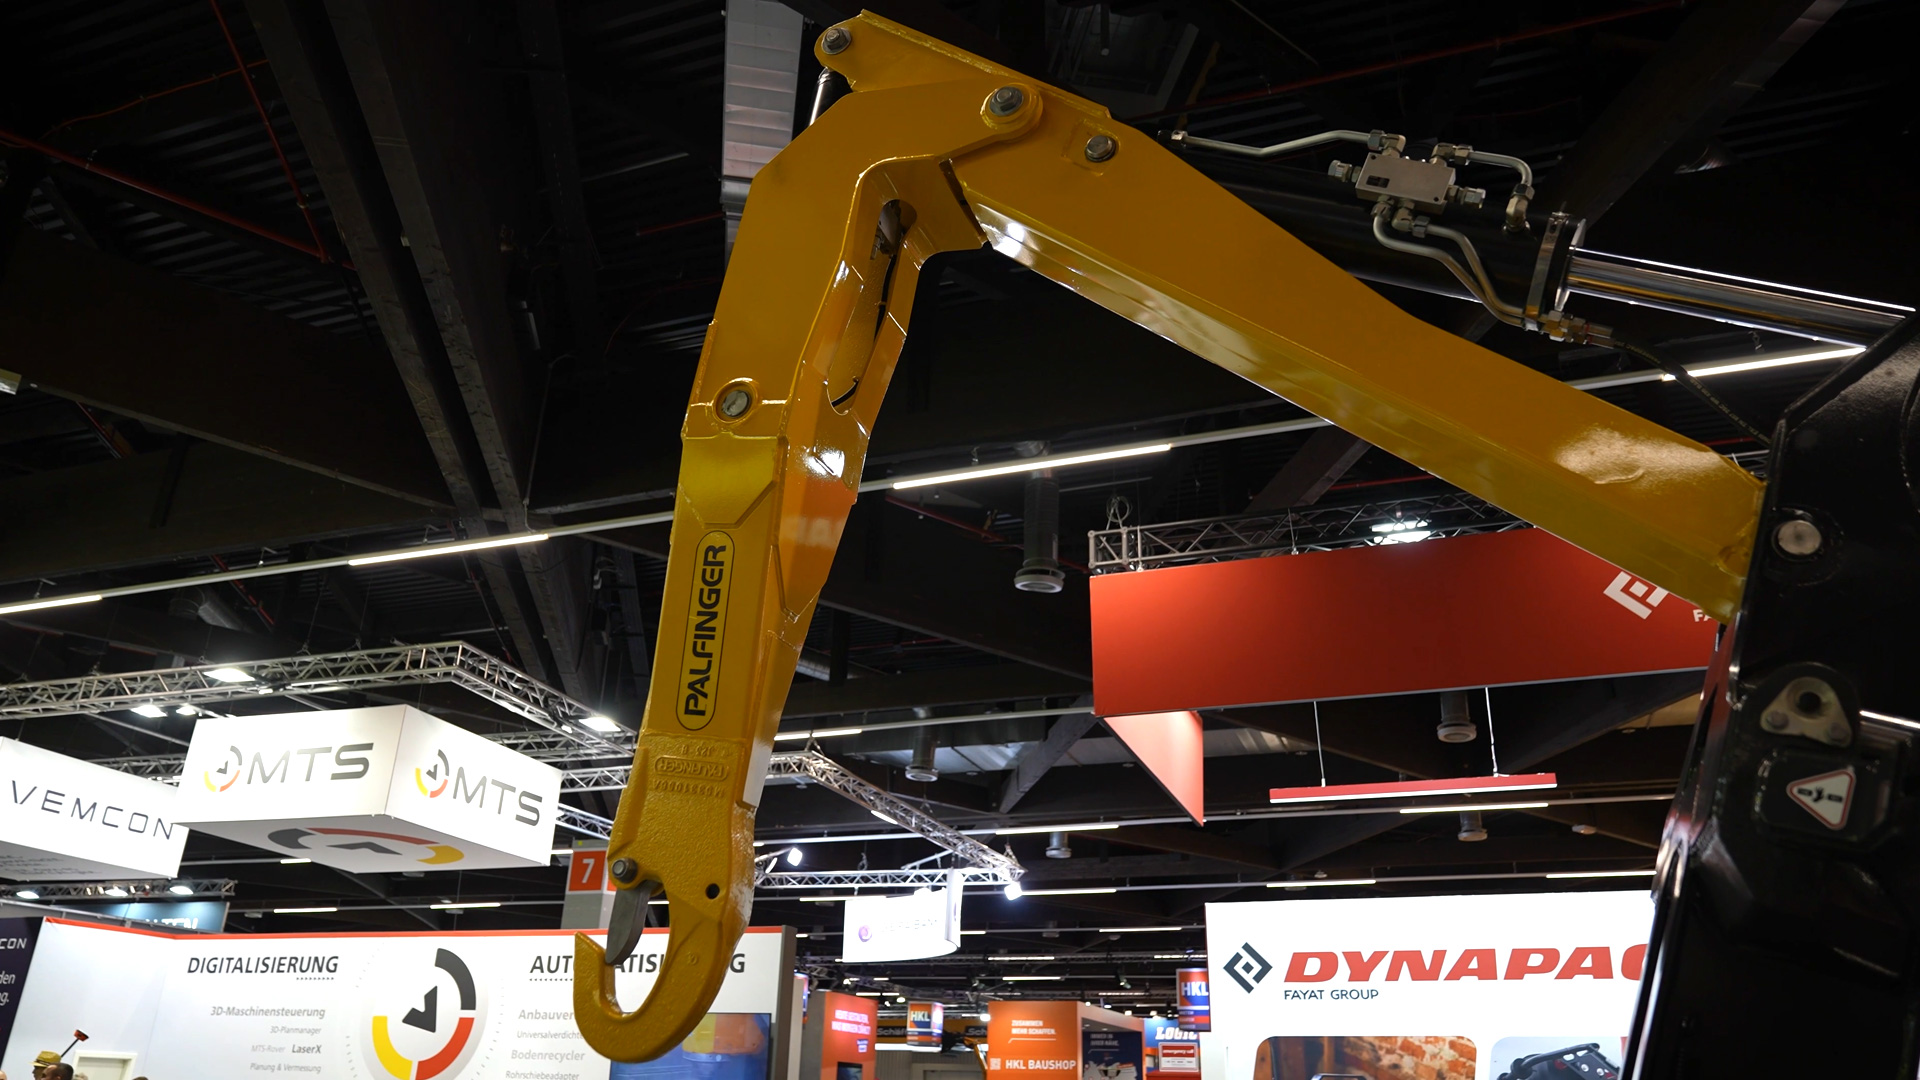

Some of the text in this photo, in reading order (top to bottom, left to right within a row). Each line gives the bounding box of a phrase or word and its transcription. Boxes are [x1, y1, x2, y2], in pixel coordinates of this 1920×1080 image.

[684, 544, 727, 717] PALFINGER
[247, 742, 374, 785] MTS
[452, 766, 543, 827] MTS
[12, 780, 174, 840] VEMCON
[581, 858, 595, 884] 7
[187, 956, 339, 974] DIGITALISIERUNG
[1181, 981, 1209, 996] HKL
[1284, 989, 1379, 1000] FAYAT GROUP
[210, 1006, 326, 1020] 3D-Maschinensteuerung
[518, 1009, 575, 1020] Anbauver
[910, 1010, 931, 1022] HKL
[517, 1030, 585, 1040] Universalverdichte
[511, 1049, 586, 1063] Bodenrecycler
[250, 1063, 276, 1074] Planung
[1005, 1059, 1077, 1070] HKL BAUSHOP
